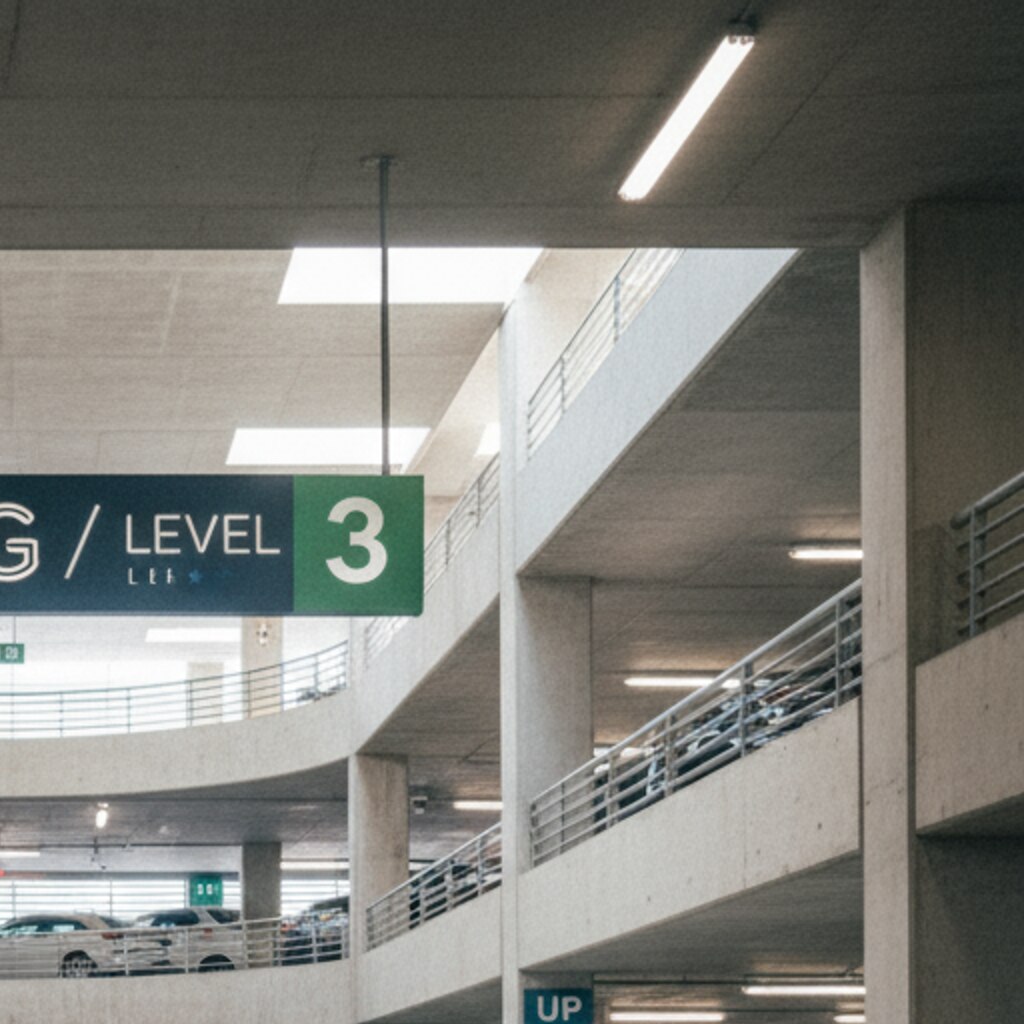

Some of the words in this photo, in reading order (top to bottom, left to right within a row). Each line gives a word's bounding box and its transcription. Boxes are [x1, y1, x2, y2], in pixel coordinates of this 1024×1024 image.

[124, 513, 281, 555] LEVEL
[325, 496, 388, 585] 3
[536, 995, 582, 1022] UP
